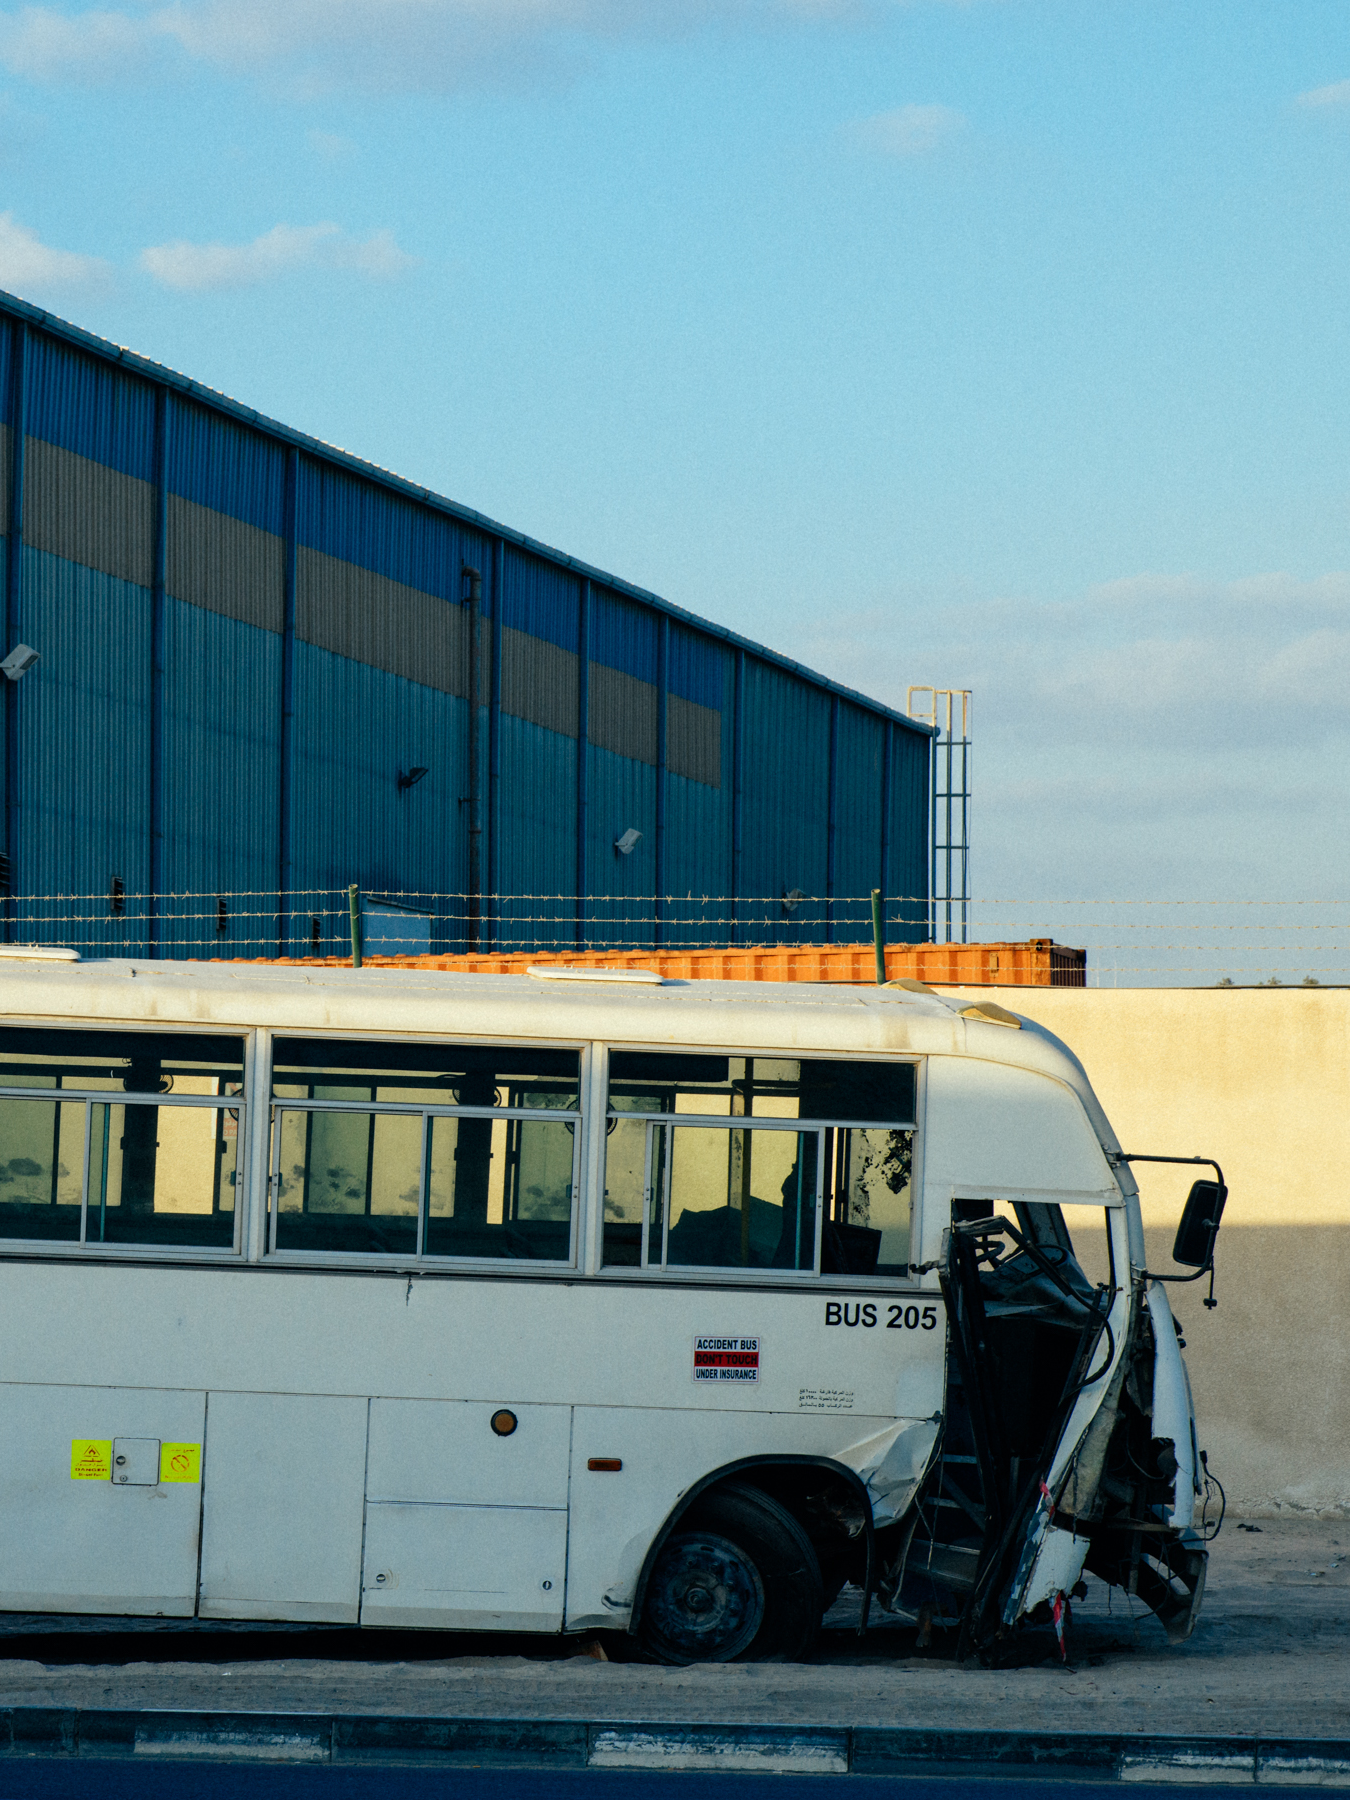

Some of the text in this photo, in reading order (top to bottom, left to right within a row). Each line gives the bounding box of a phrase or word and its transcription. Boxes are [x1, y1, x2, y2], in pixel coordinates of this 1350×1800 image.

[825, 1302, 937, 1330] BUS 205
[697, 1339, 757, 1351] ACCIDENT BUS
[696, 1354, 758, 1365] DON'T TOUCH
[696, 1369, 756, 1380] UNDER INSURANCE
